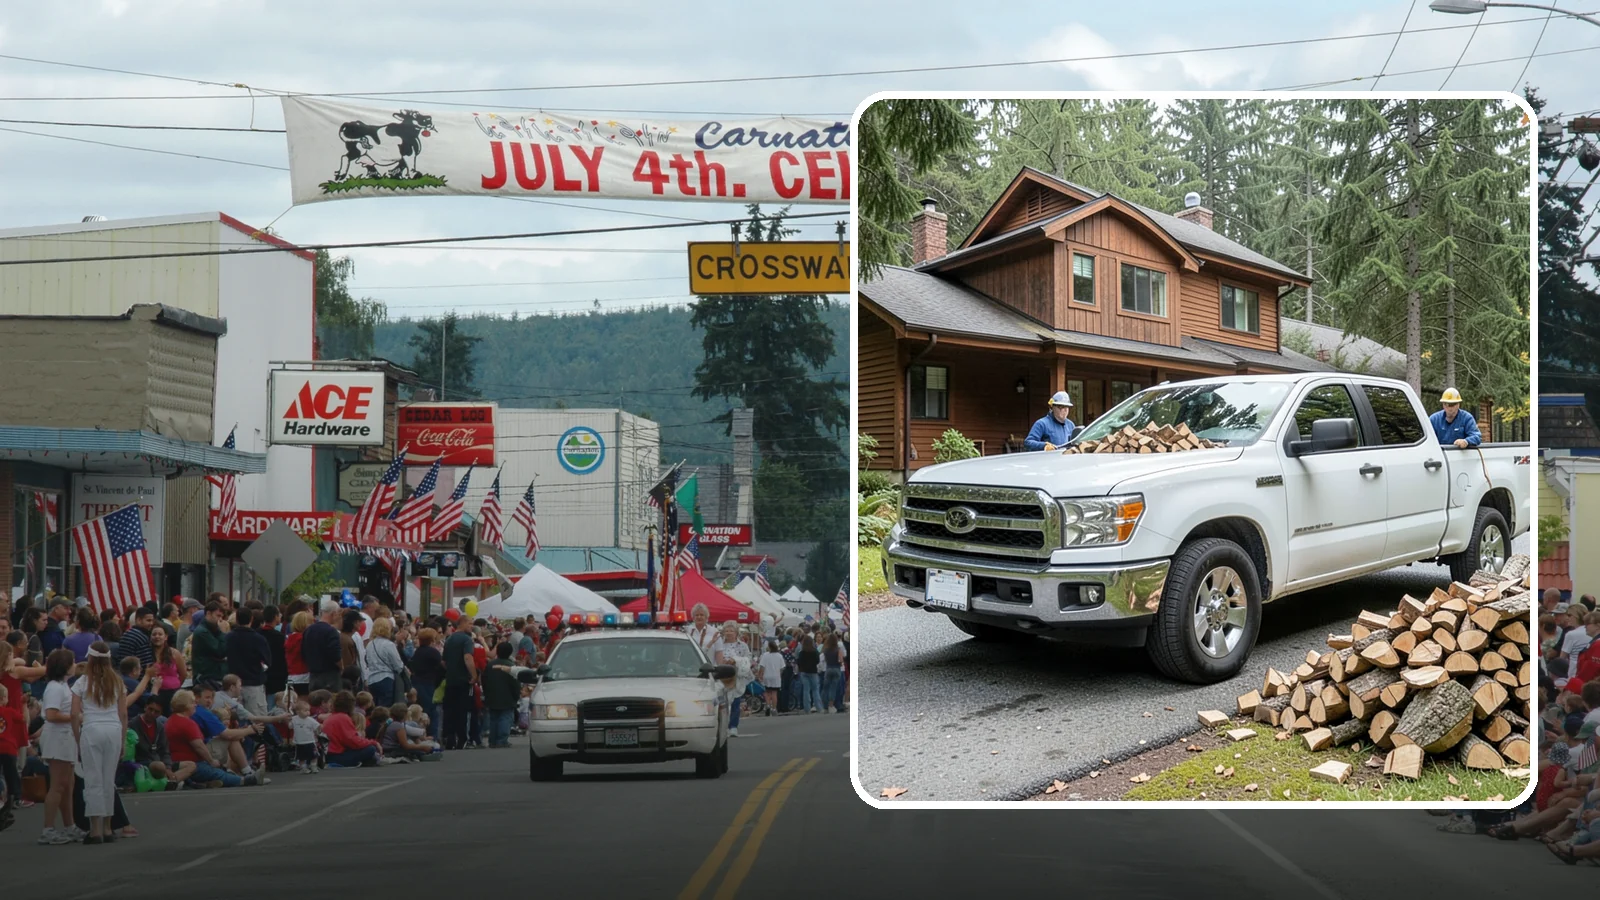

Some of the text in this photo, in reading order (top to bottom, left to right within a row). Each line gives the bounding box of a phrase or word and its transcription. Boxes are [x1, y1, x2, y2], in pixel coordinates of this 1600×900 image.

[481, 140, 605, 193] JULY
[632, 150, 746, 197] 4th.
[697, 254, 850, 280] CROSSWA
[282, 380, 374, 420] ACE
[406, 409, 485, 423] CEDAR LOG
[283, 421, 371, 437] Hardware
[416, 428, 477, 447] Coca-Cola
[353, 467, 386, 481] Simpl
[83, 485, 155, 495] St. Vincent de Paul
[688, 526, 741, 535] CRNATION
[699, 535, 730, 543] GLASS
